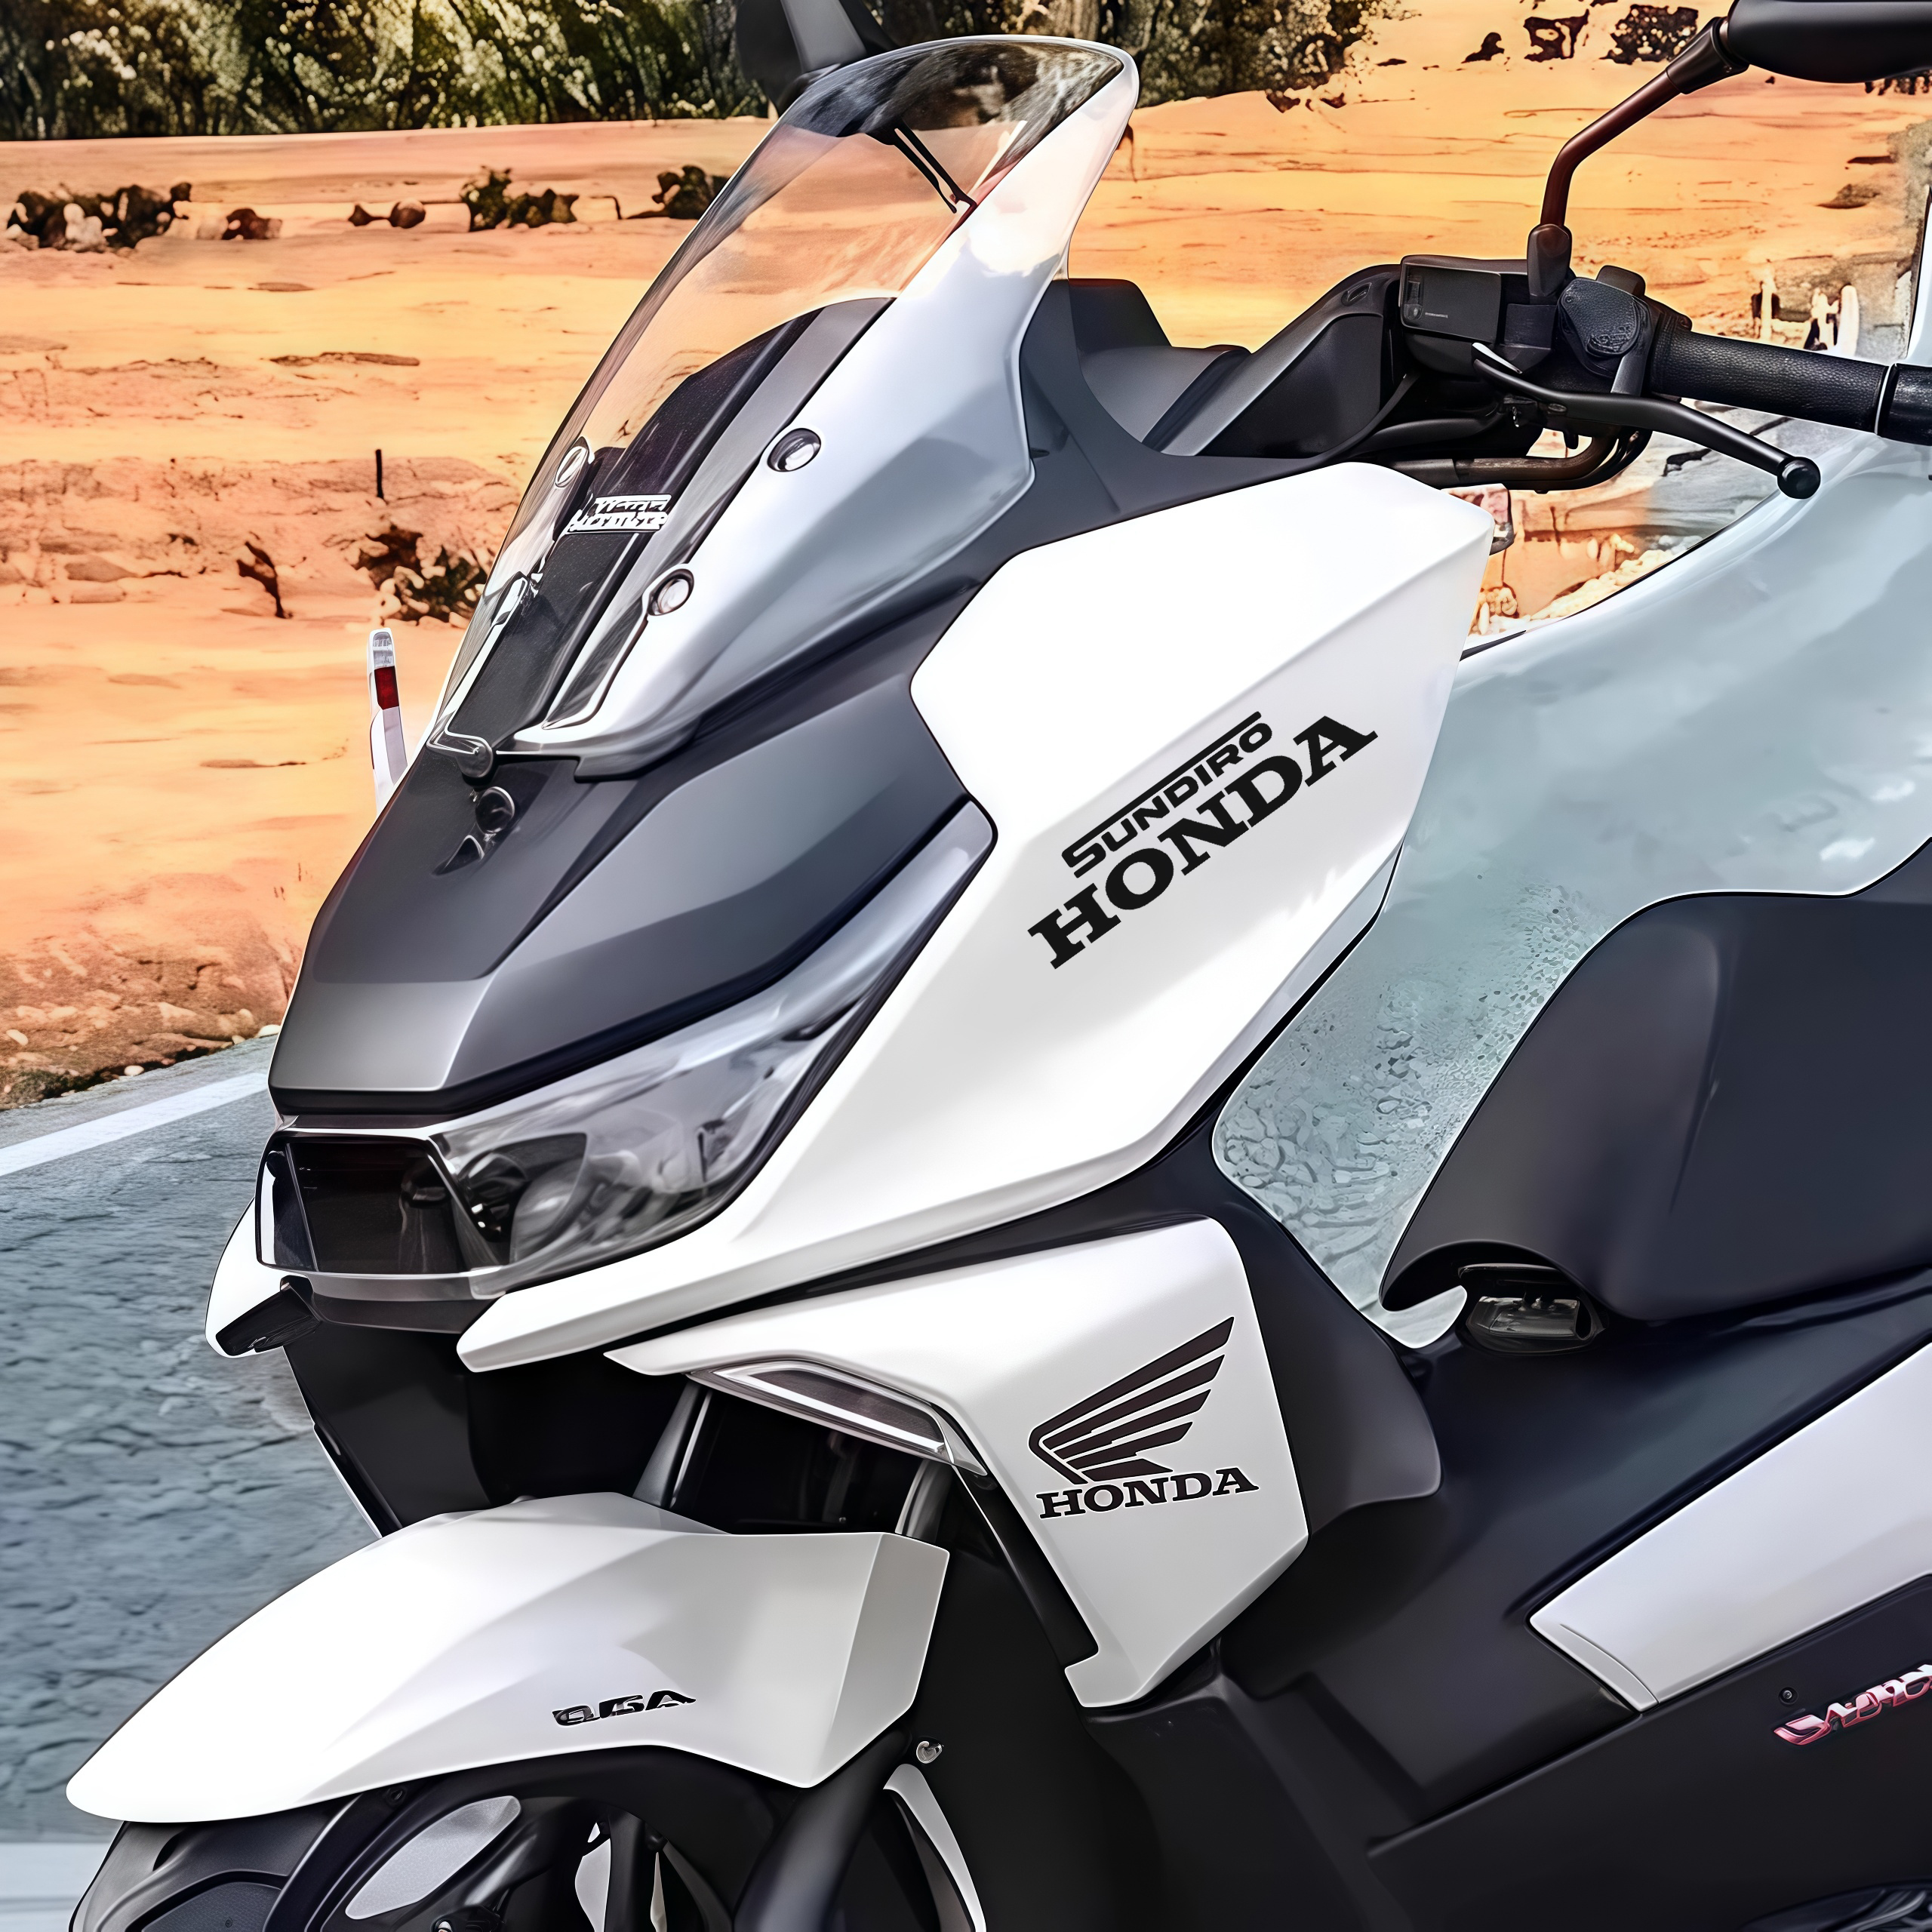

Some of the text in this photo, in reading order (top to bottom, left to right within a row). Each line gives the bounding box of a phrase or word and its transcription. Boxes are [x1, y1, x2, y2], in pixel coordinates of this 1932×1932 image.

[1027, 715, 1378, 970] HONDA
[1061, 712, 1272, 878] SUNDIRO
[1035, 1466, 1260, 1519] HONDA
